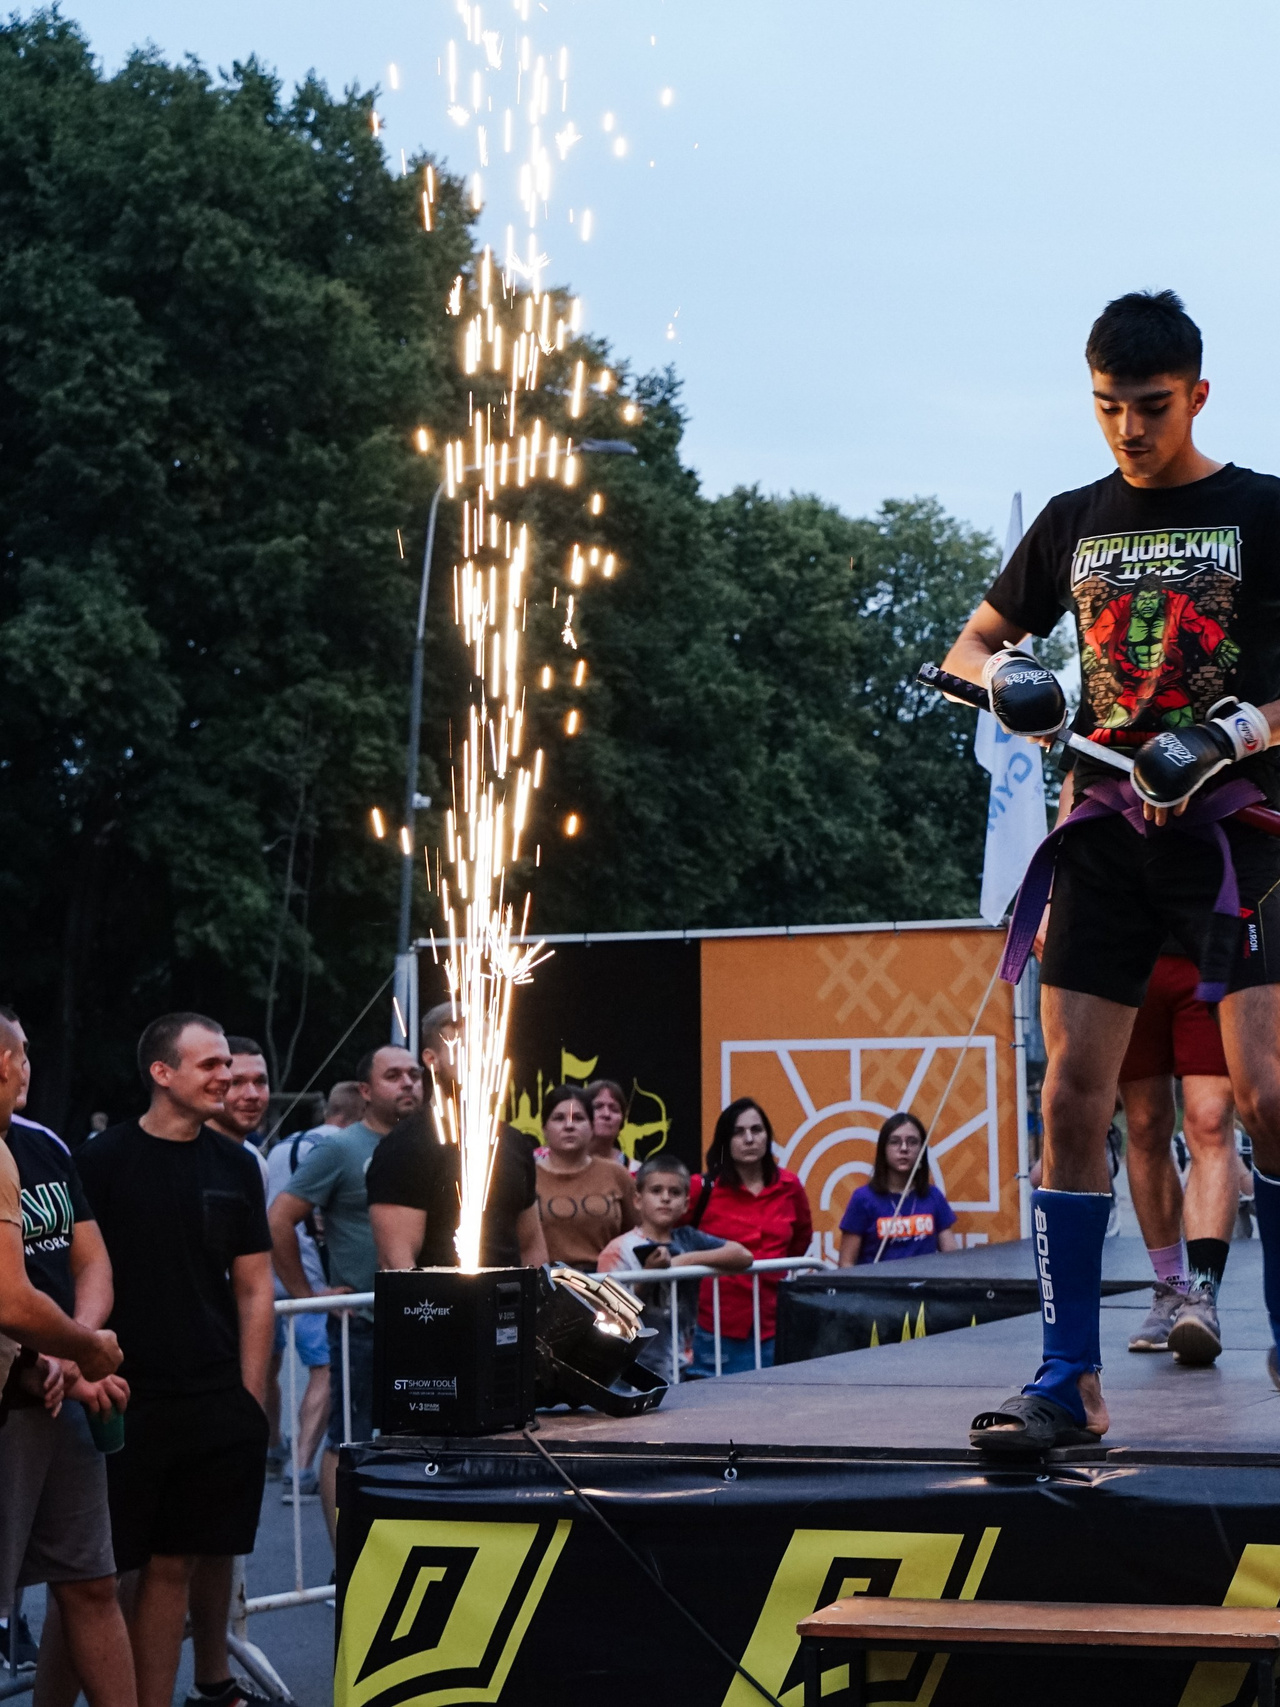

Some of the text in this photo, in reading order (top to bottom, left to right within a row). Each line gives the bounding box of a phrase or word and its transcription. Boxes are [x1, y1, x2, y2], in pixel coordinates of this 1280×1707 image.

[1073, 528, 1238, 583] БОРЦОВСКИЙ
[1247, 923, 1259, 952] AKRON
[36, 1235, 70, 1252] YORK
[394, 1379, 408, 1390] ST
[408, 1379, 431, 1387] SHOW
[433, 1379, 457, 1388] TOOLS
[409, 1402, 424, 1412] V-3
